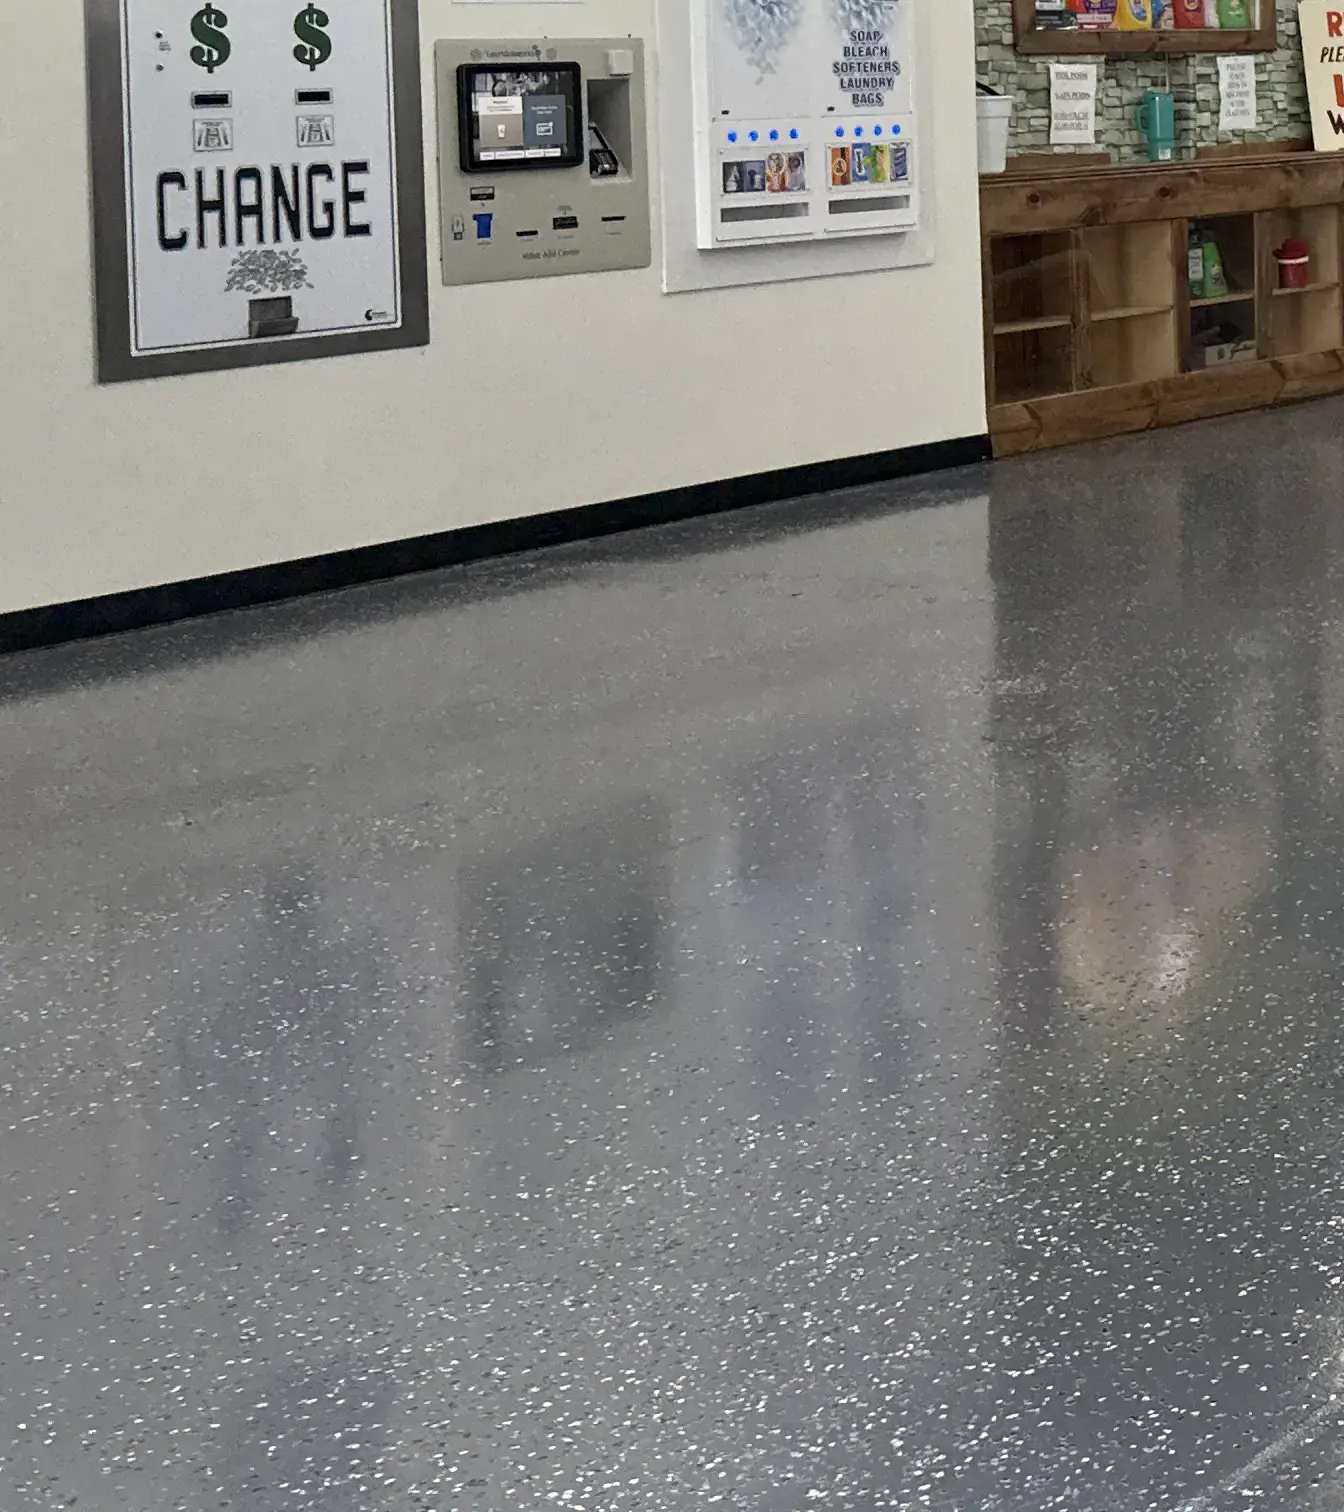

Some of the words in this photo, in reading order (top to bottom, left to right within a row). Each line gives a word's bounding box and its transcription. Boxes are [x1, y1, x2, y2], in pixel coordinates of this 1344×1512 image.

[190, 2, 231, 74] $
[293, 2, 332, 72] $
[850, 30, 880, 41] SOAP
[844, 46, 887, 57] BLEACH
[833, 61, 899, 73] SOFTENERS
[840, 77, 893, 89] LAUNDRY
[852, 93, 882, 104] BAGS
[157, 160, 372, 252] CHANGE
